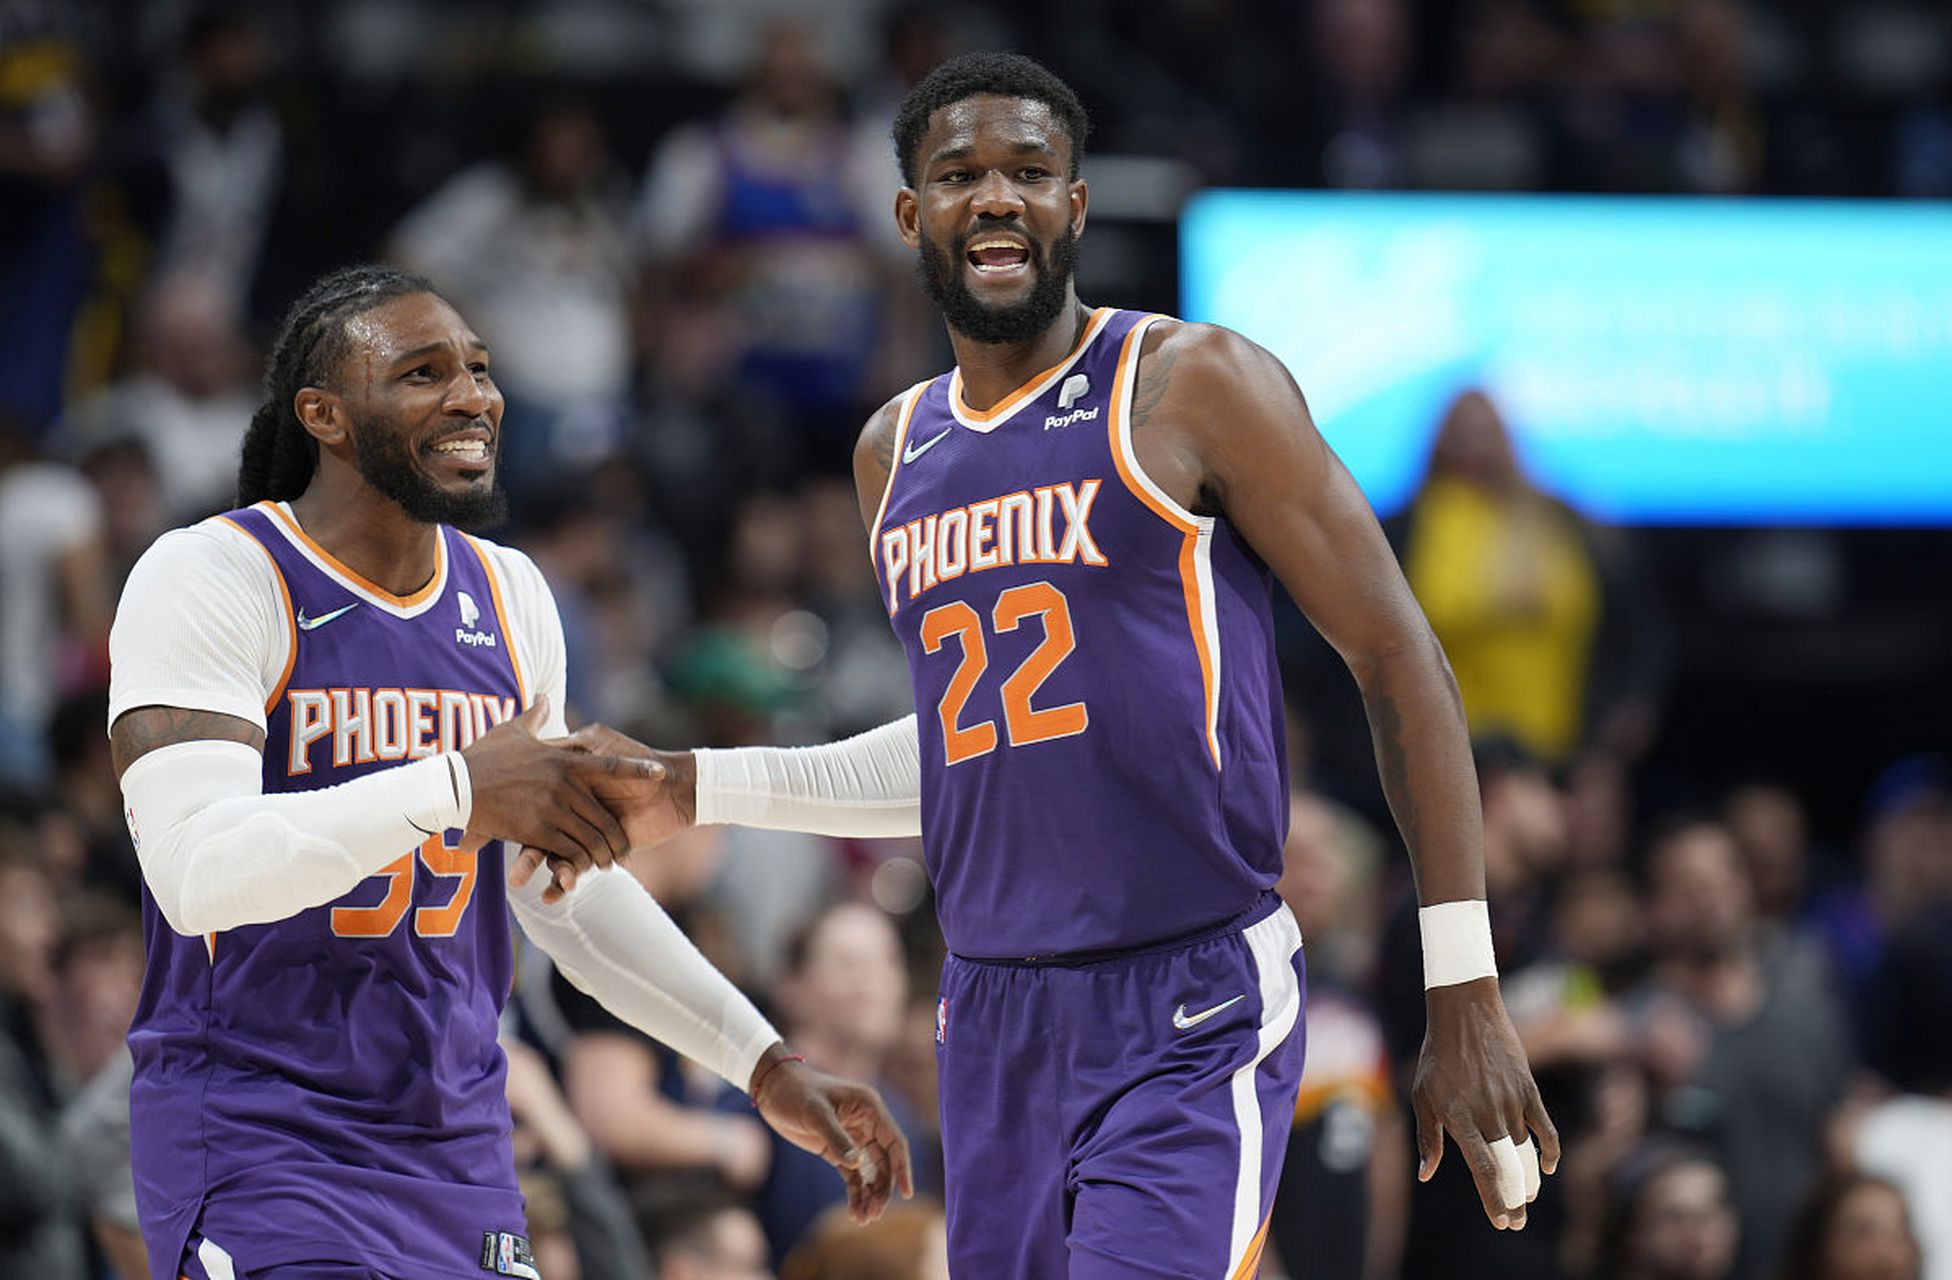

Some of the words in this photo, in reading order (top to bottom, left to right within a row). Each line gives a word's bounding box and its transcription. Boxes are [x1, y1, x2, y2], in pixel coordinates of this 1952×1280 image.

[1044, 407, 1099, 430] PayPal
[882, 479, 1109, 618] PHOENIX
[456, 629, 496, 646] PayPal
[920, 580, 1089, 767] 22
